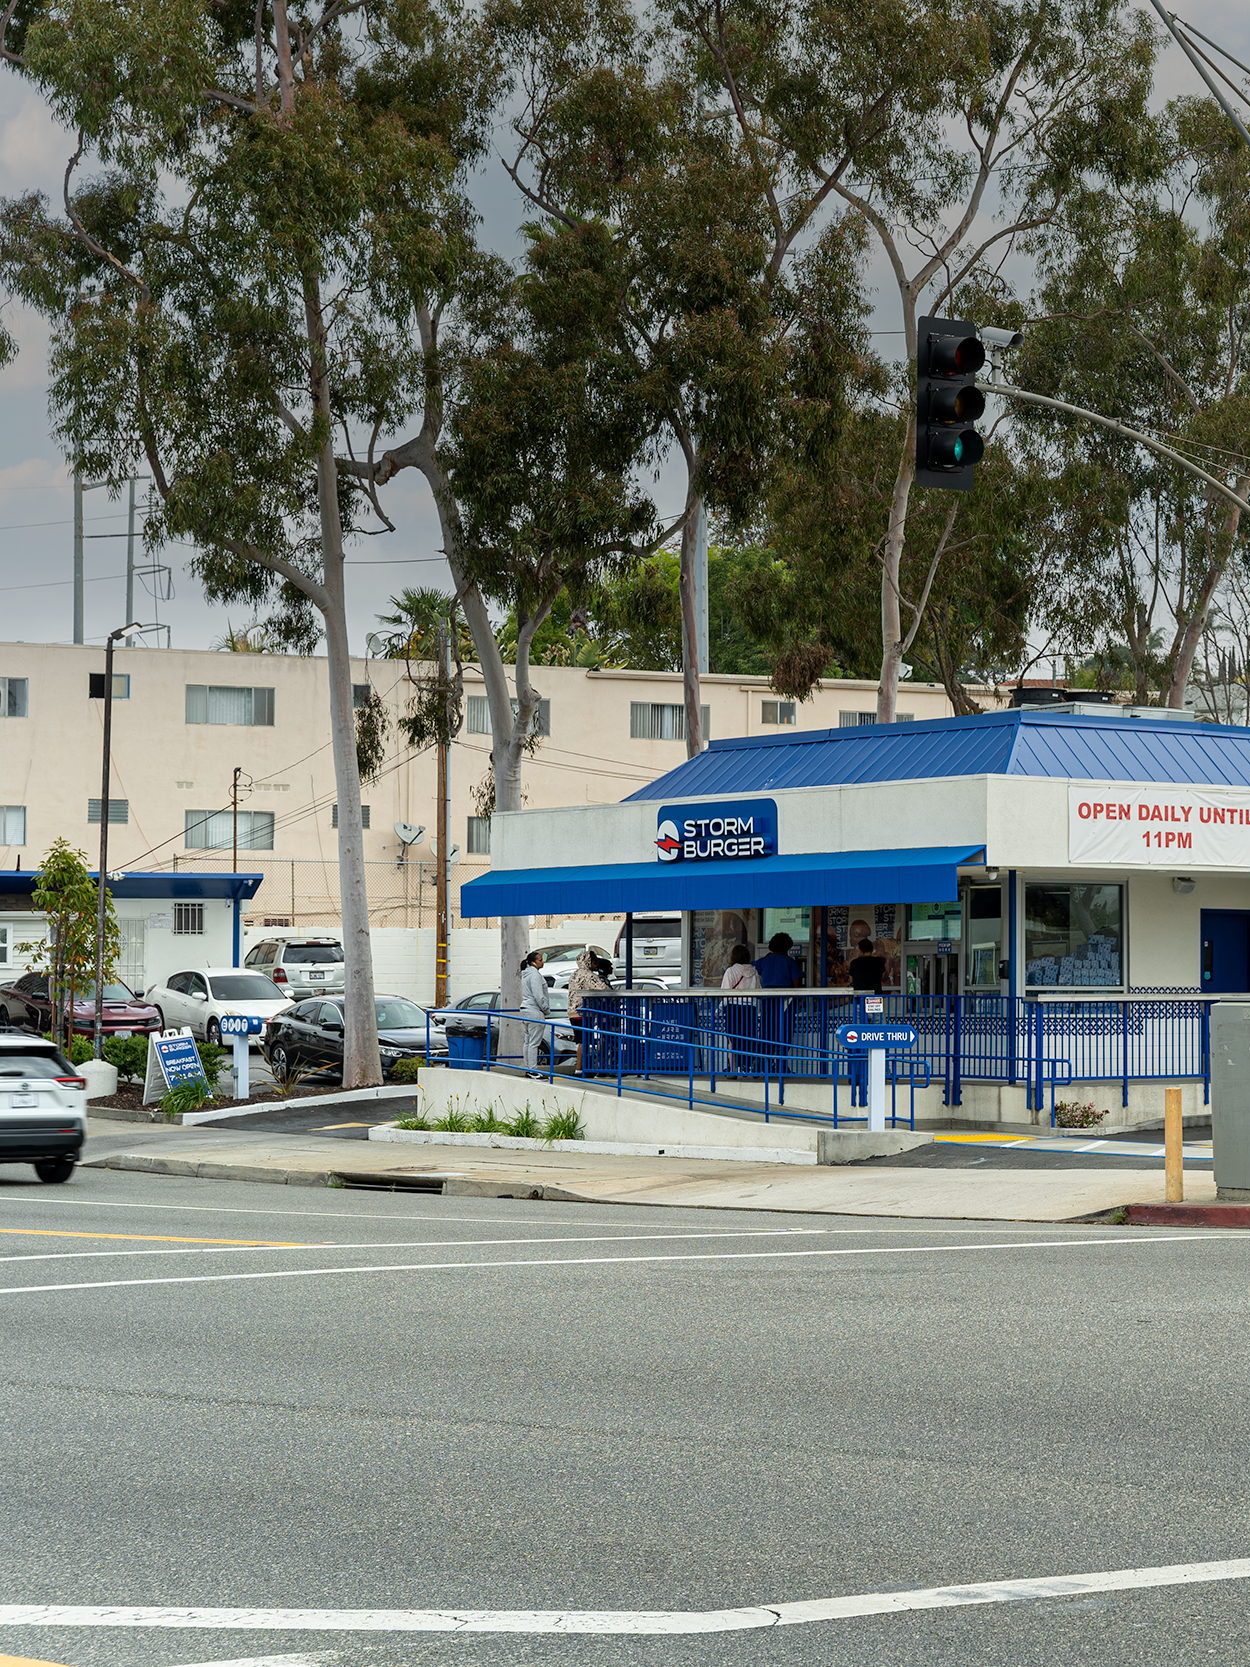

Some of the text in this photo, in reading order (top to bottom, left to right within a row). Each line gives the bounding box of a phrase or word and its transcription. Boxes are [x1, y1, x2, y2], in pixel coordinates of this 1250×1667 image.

[1078, 803, 1131, 820] OPEN
[1138, 804, 1193, 823] DAILY
[684, 816, 754, 838] STORM
[1142, 831, 1192, 849] 11PM
[684, 837, 765, 859] BURGER
[222, 1019, 247, 1031] EXIT
[861, 1032, 907, 1041] DRIVE THRU
[165, 1056, 195, 1066] BREAKFAST
[181, 1062, 200, 1071] OPEN
